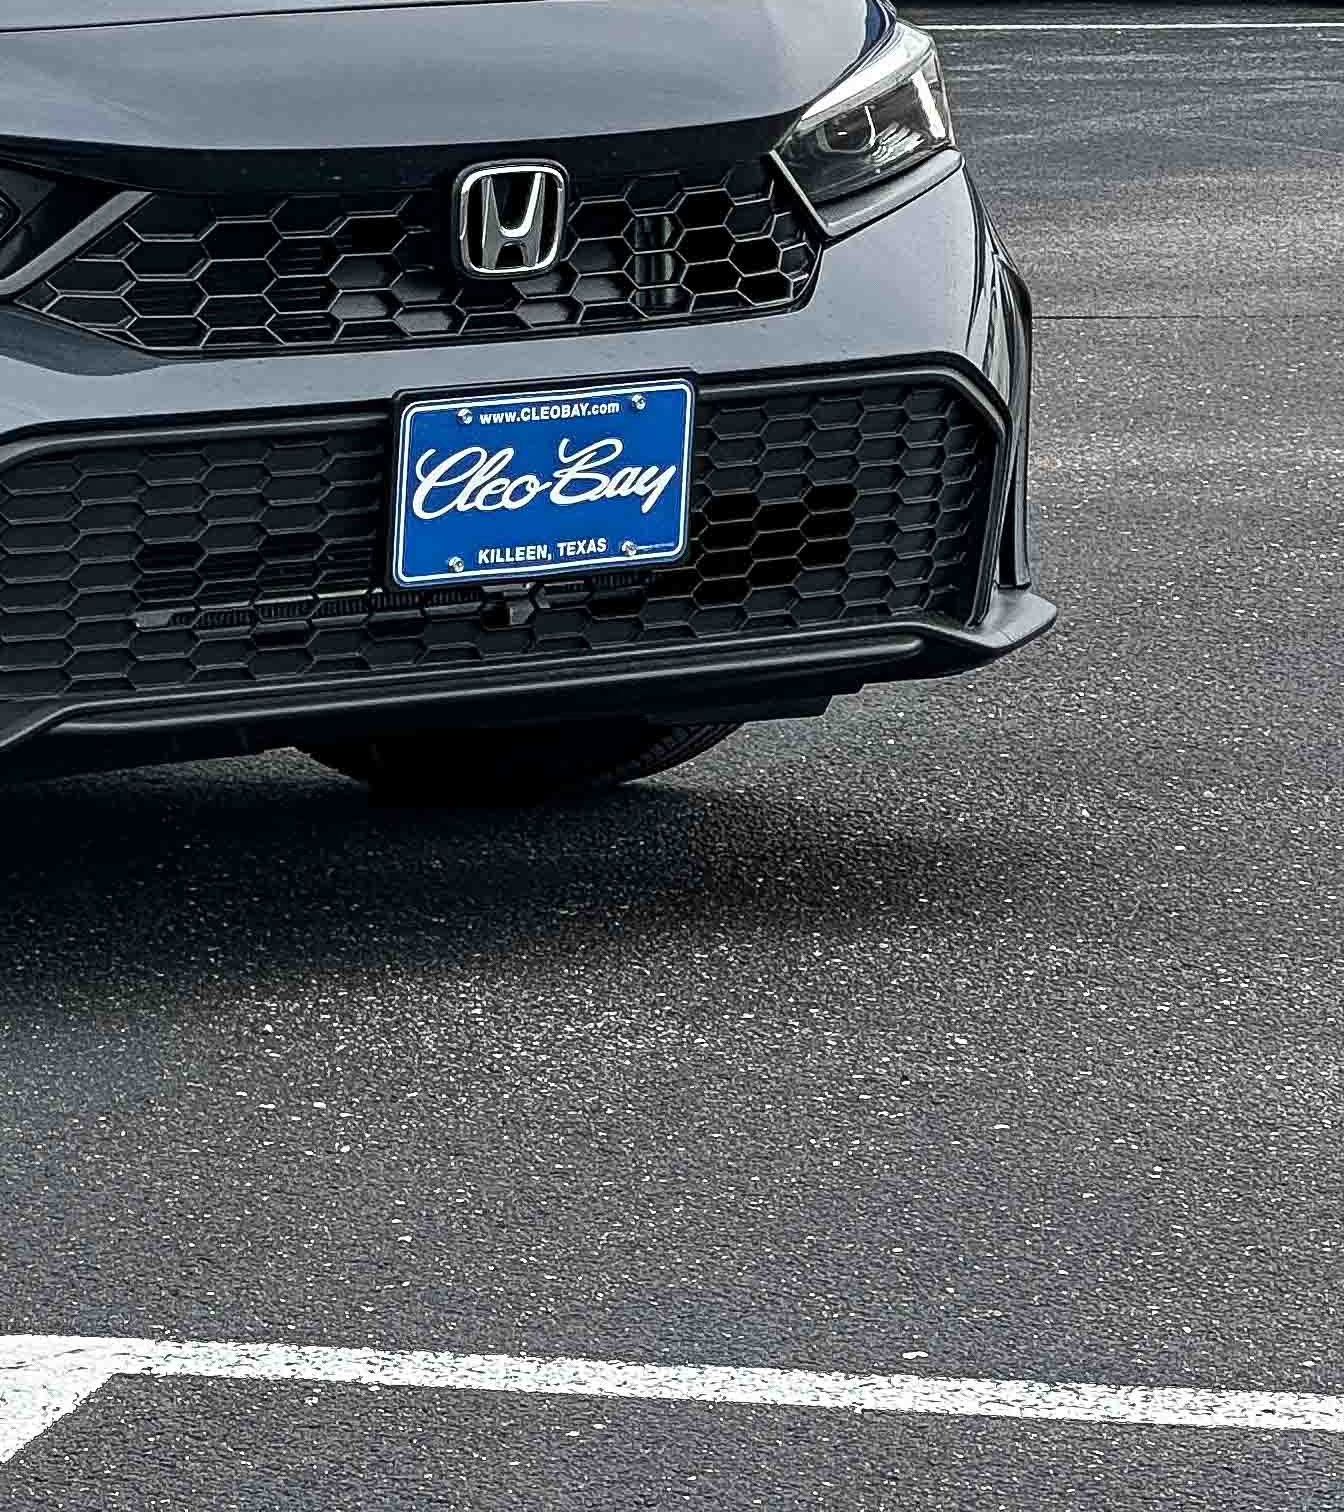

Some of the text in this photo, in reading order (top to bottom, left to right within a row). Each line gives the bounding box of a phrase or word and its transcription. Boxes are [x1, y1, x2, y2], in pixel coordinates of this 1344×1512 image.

[479, 402, 620, 425] www.CLEOBAY.com
[412, 437, 677, 520] Cleo Bay
[477, 538, 608, 564] KILLEEN, TEXAS
